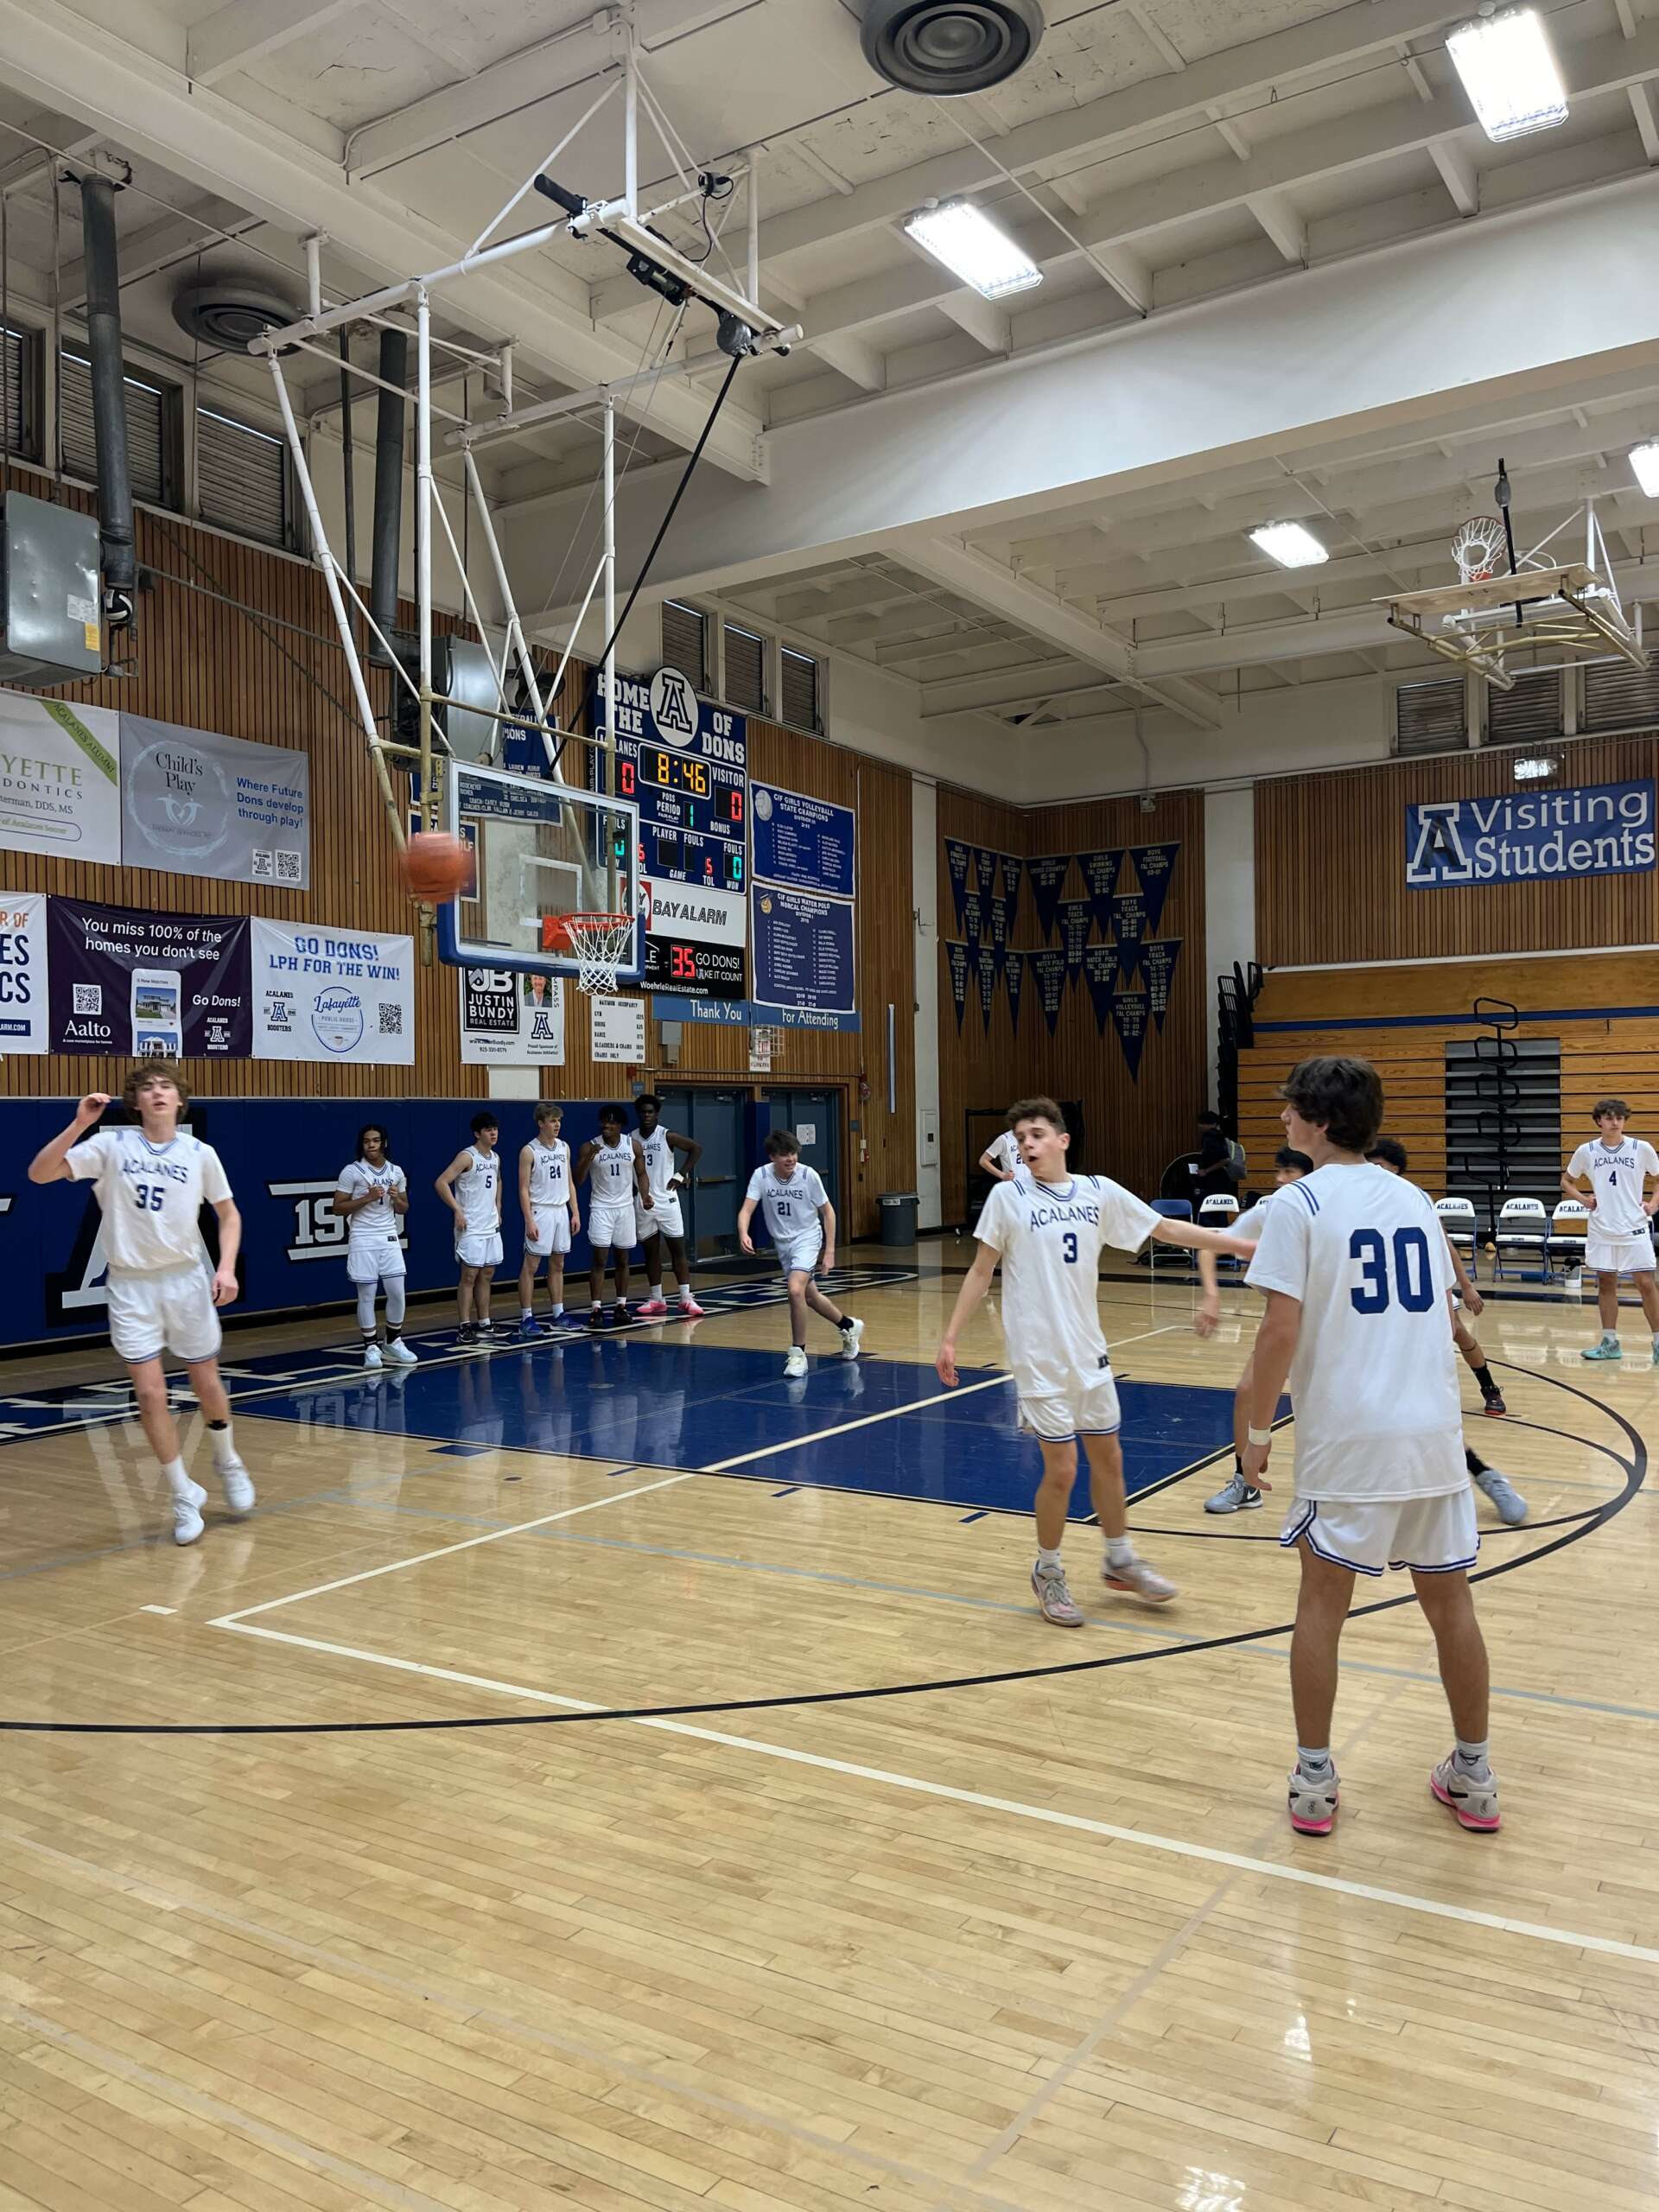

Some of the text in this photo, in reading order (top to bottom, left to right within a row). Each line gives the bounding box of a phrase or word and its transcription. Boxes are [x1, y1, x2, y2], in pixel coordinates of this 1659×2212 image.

[614, 703, 745, 764] HE DONS
[713, 711, 733, 737] OF
[1, 753, 83, 786] YETTE
[156, 753, 203, 777] Child's
[658, 753, 706, 794] 8:46
[167, 772, 197, 796] Play
[622, 761, 634, 795] 0
[711, 766, 745, 788] VISITOR
[3, 778, 83, 800] DONTICS
[237, 778, 303, 799] Where Future
[662, 791, 676, 802] POSS
[35, 800, 73, 815] DDS, MS
[237, 791, 304, 816] Dons develop
[656, 800, 681, 817] PERIOD
[731, 791, 742, 822] 0
[779, 803, 829, 823] STATE CHAMPIONS
[784, 796, 801, 807] GIRLS
[801, 800, 835, 817] VOLLEYBALL
[1470, 791, 1649, 834] Visiting
[238, 807, 304, 830] through play!
[709, 821, 731, 836] BONUS
[652, 825, 704, 848] PLAYER FOULS
[1406, 802, 1473, 883] A
[723, 842, 743, 855] FOULS
[1475, 829, 1656, 879] Students
[669, 868, 687, 881] GAME
[705, 856, 713, 875] 5
[733, 856, 742, 880] 0
[702, 874, 715, 887] TOL
[652, 899, 681, 918] BAY
[680, 904, 728, 926] ALARM
[785, 895, 801, 904] GIRLS
[817, 901, 830, 910] POLO
[800, 905, 828, 916] CHAMPIONS
[14, 912, 29, 928] OF
[82, 917, 222, 944] You miss 100% of the
[85, 937, 220, 962] homes you don't see
[295, 936, 379, 962] GO DONS!
[269, 954, 400, 981] LPH FOR THE WIN!
[672, 946, 696, 979] 35
[696, 952, 740, 969] GO DONS!
[0, 970, 31, 1003] CS
[714, 970, 743, 982] IT COUNT
[265, 990, 294, 999] ACALANES
[640, 981, 709, 995] WoehrleRealEstate.com
[192, 994, 241, 1007] Go Dons!
[314, 995, 361, 1014] Lafayette
[468, 993, 514, 1007] JUSTIN
[469, 1006, 515, 1020] BUNDY
[690, 999, 721, 1020] Thank
[723, 1001, 742, 1020] You
[798, 1010, 839, 1030] Attending
[65, 1020, 111, 1037] Aalto
[540, 1154, 566, 1165] ACALANES
[599, 1153, 632, 1163] ACALANES
[1593, 1156, 1635, 1169] ACALANES
[122, 1159, 188, 1184] ACALANES
[550, 1165, 561, 1179] 24
[610, 1163, 620, 1176] 11
[1609, 1170, 1617, 1186] 4
[486, 1175, 492, 1189] 5
[135, 1184, 166, 1211] 35
[767, 1188, 803, 1200] ACALANES
[778, 1201, 791, 1217] 21
[1030, 1206, 1100, 1232] ACALANES
[1062, 1232, 1078, 1264] 3
[1349, 1226, 1434, 1315] 30
